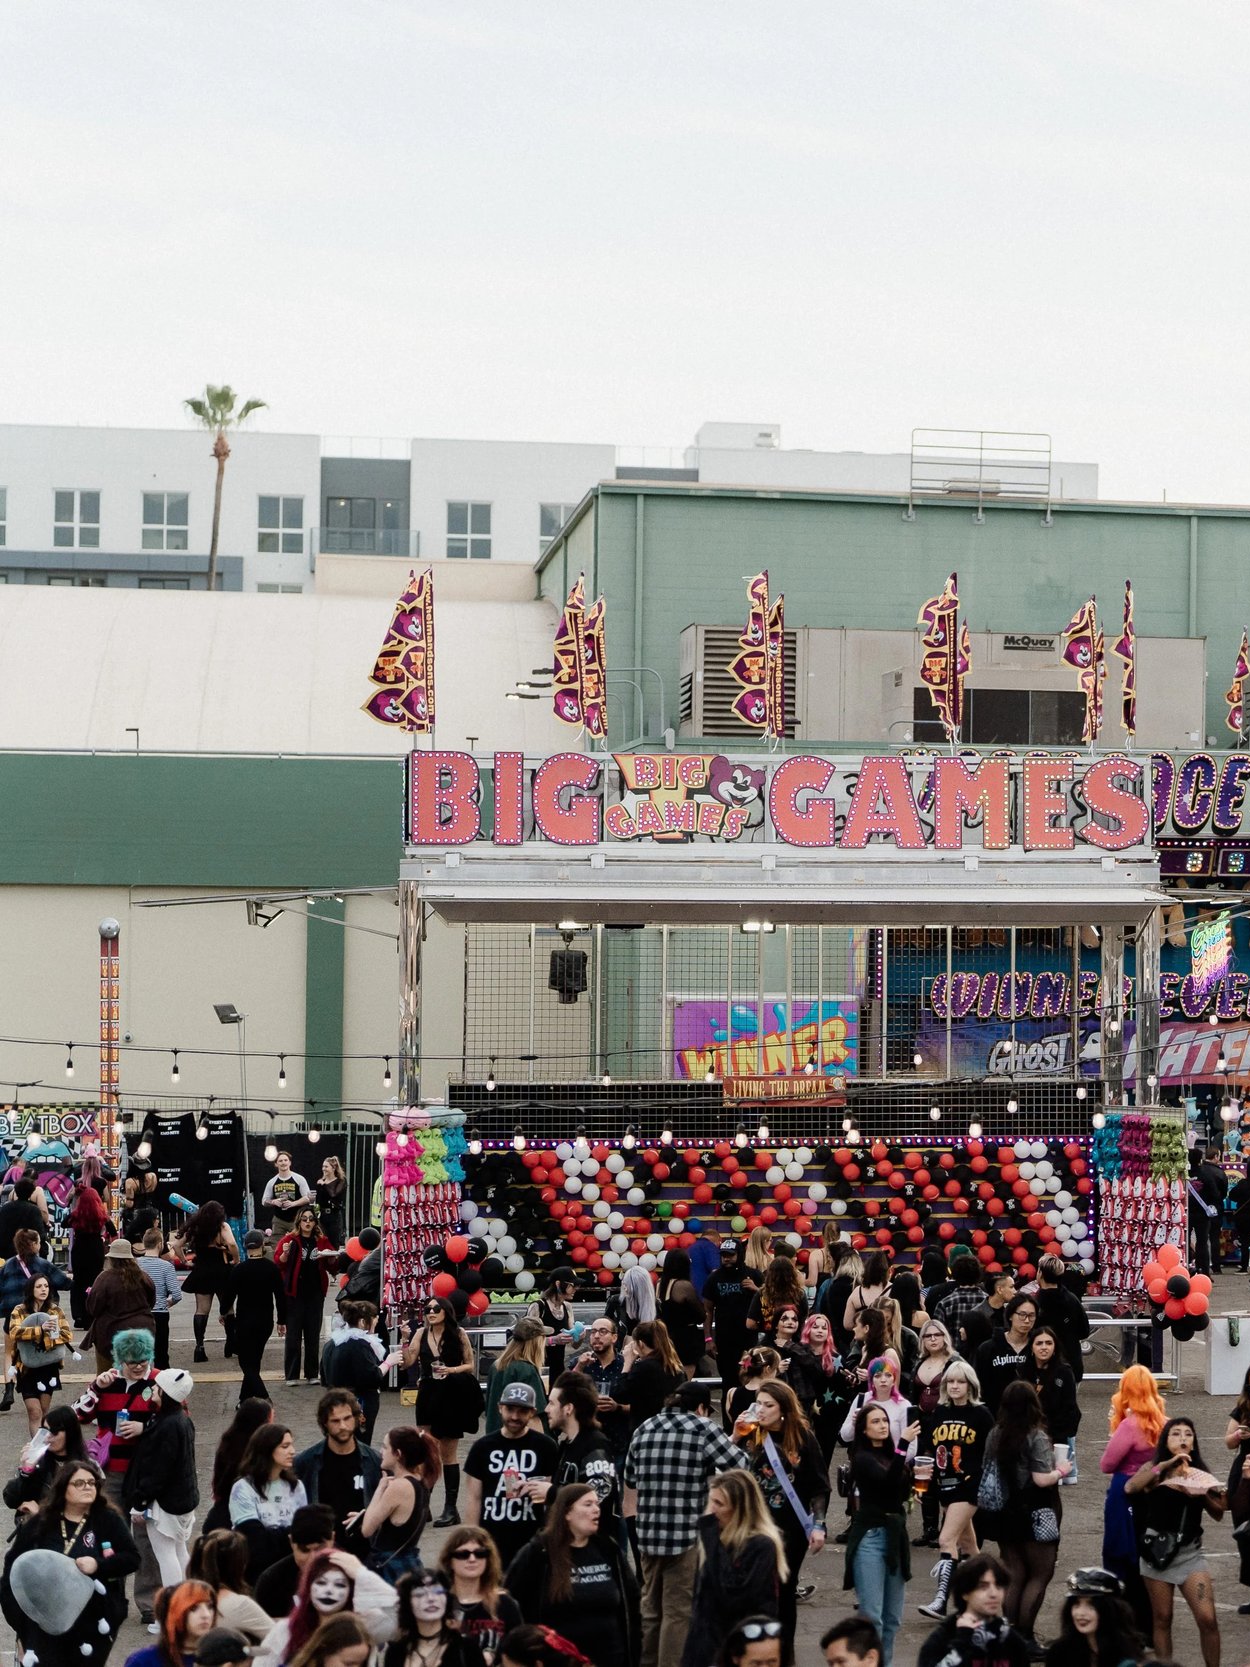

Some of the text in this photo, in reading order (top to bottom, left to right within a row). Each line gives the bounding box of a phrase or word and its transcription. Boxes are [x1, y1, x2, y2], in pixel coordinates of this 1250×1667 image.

[1004, 636, 1054, 647] McQuay
[633, 755, 707, 790] BIG
[411, 750, 1152, 851] BIG GAMES
[603, 800, 750, 841] GAMES
[1186, 852, 1204, 873] 8
[1228, 852, 1245, 873] 9
[987, 1030, 1086, 1074] GHOST
[732, 1080, 827, 1099] LIVING THE DREAM
[0, 1113, 93, 1135] BEATBOX
[508, 1388, 528, 1401] 312
[488, 1449, 537, 1473] SAD
[585, 1459, 615, 1477] 2024
[483, 1496, 537, 1521] FUCK
[577, 1563, 611, 1574] AMERIC
